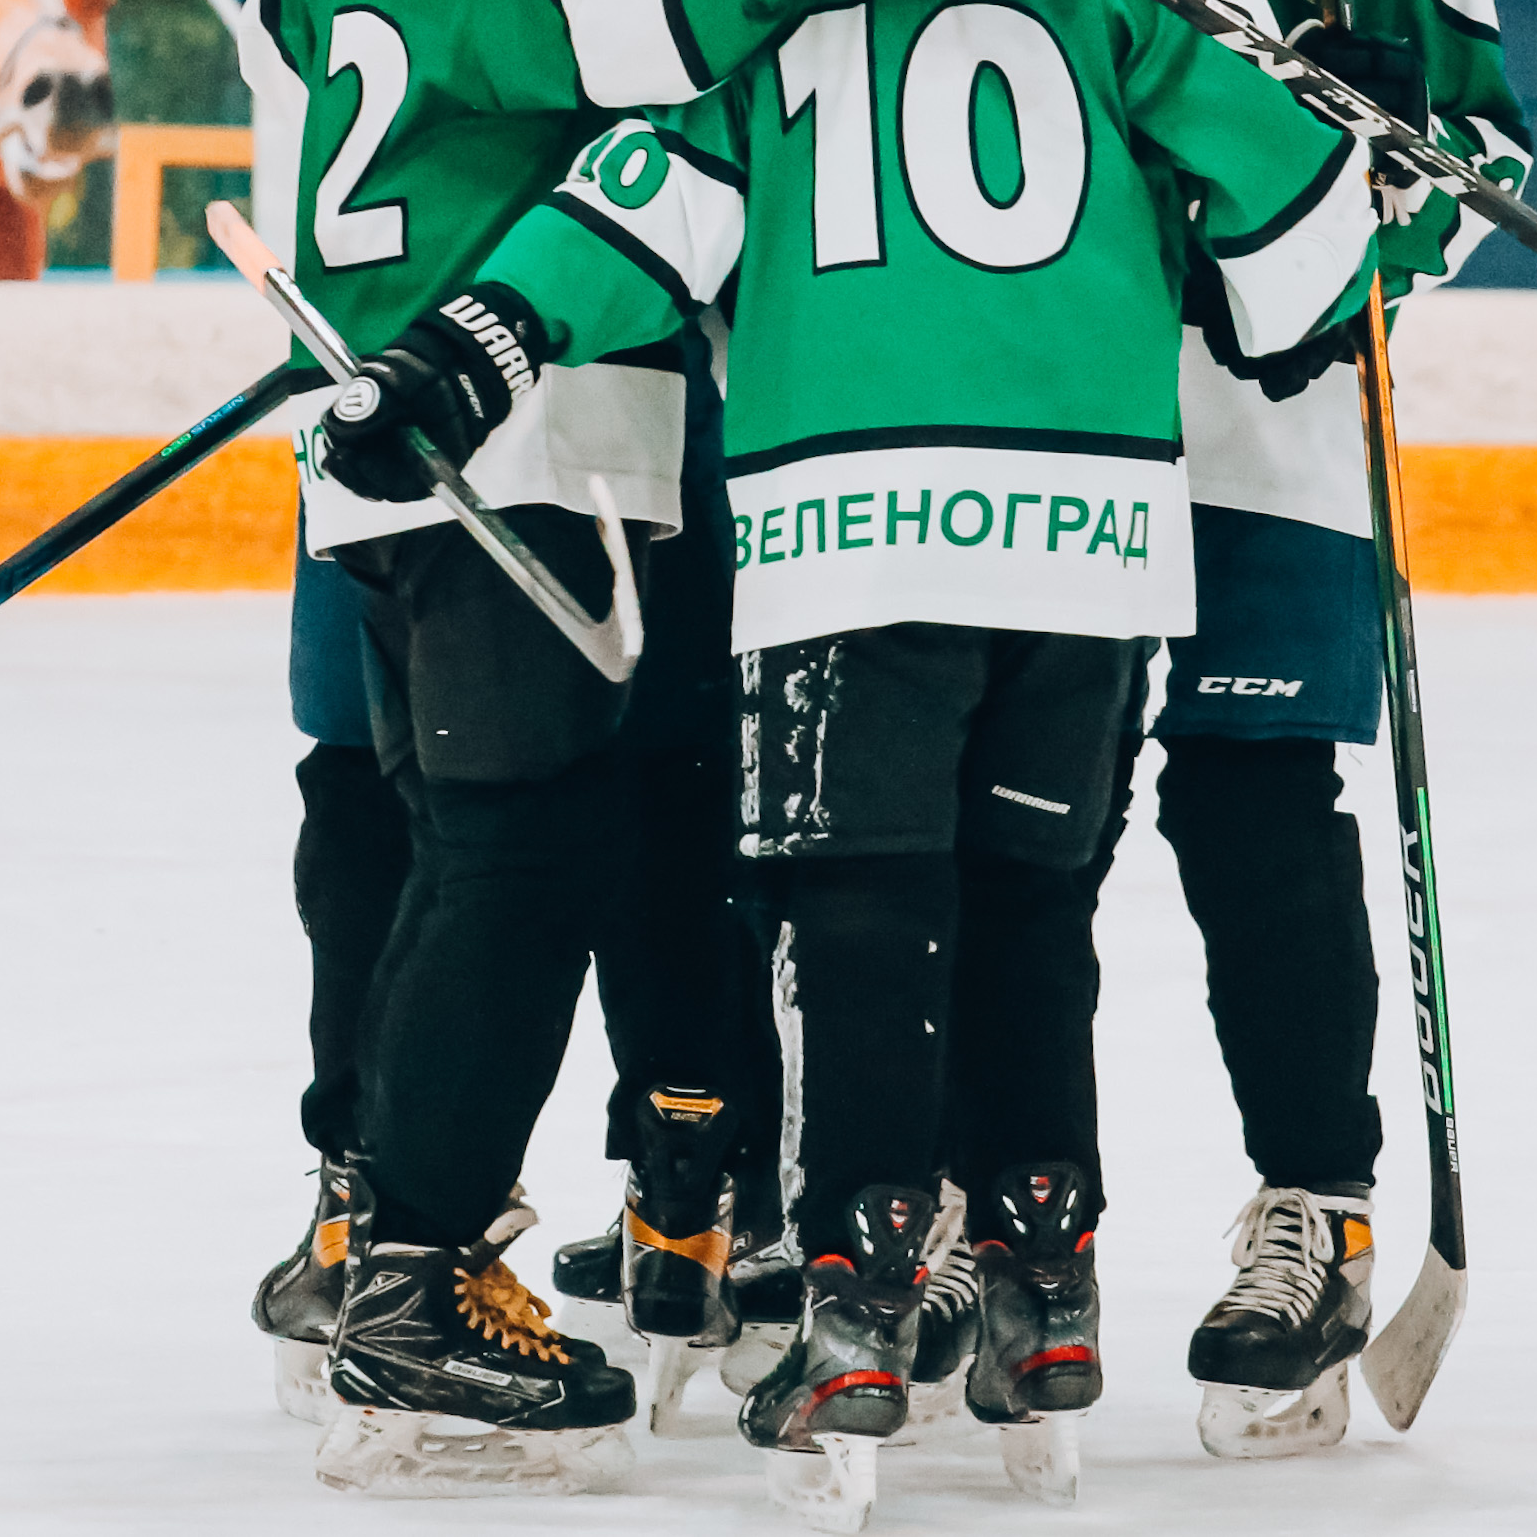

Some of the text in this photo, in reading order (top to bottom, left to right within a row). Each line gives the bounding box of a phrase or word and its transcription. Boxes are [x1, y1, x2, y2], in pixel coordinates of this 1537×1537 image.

[314, 5, 409, 271] 2
[579, 131, 670, 210] 10
[189, 395, 245, 436] NEXUS
[735, 489, 1150, 572] ЗЕЛЕНОГРАД
[1197, 676, 1304, 698] CCM
[1445, 1116, 1459, 1173] BAUER
